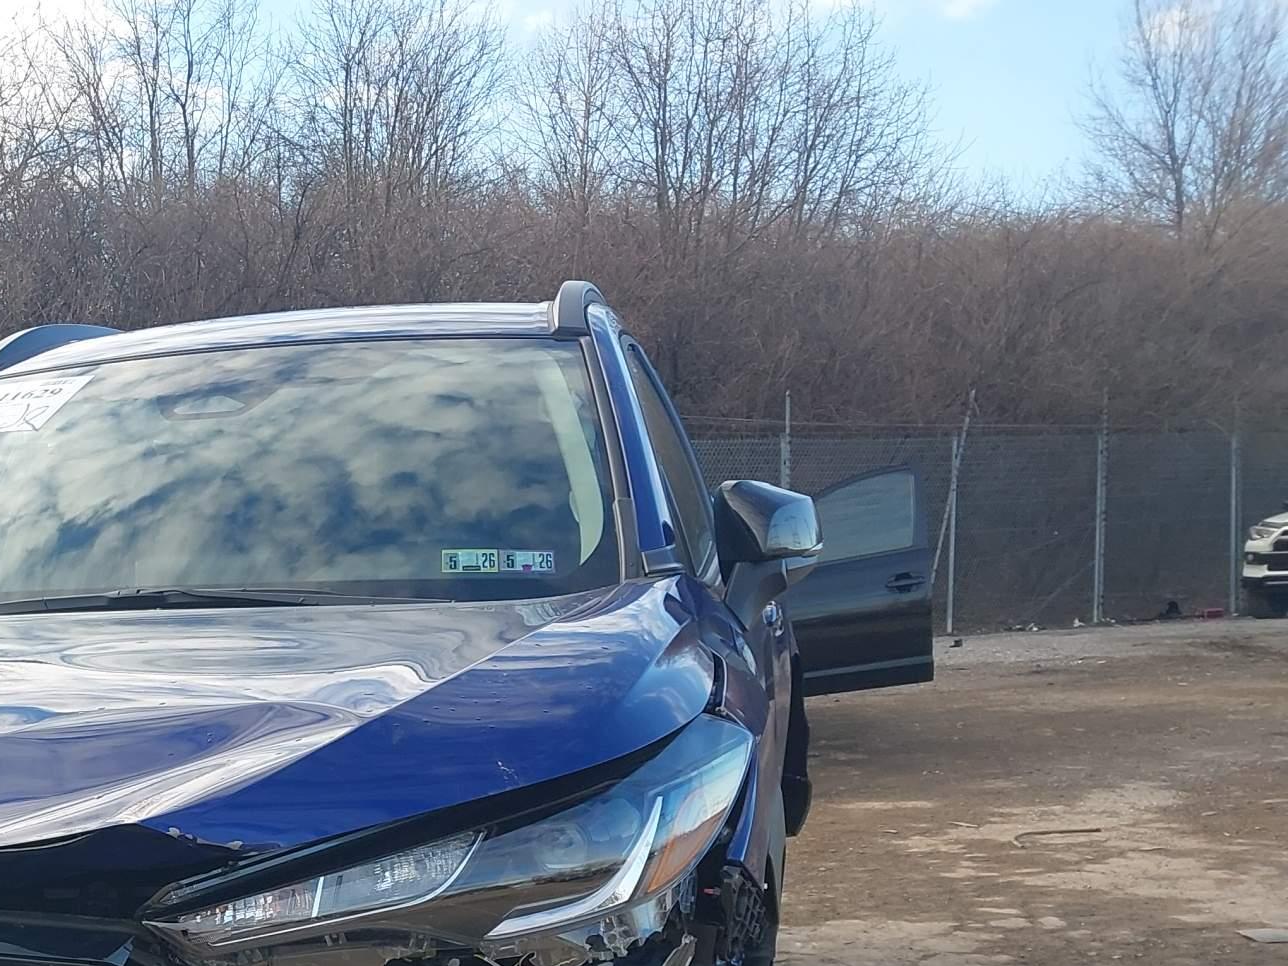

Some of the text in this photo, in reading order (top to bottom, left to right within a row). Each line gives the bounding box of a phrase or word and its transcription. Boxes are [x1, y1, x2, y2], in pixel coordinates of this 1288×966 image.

[449, 552, 496, 570] 5 26
[506, 553, 553, 569] 5 26
